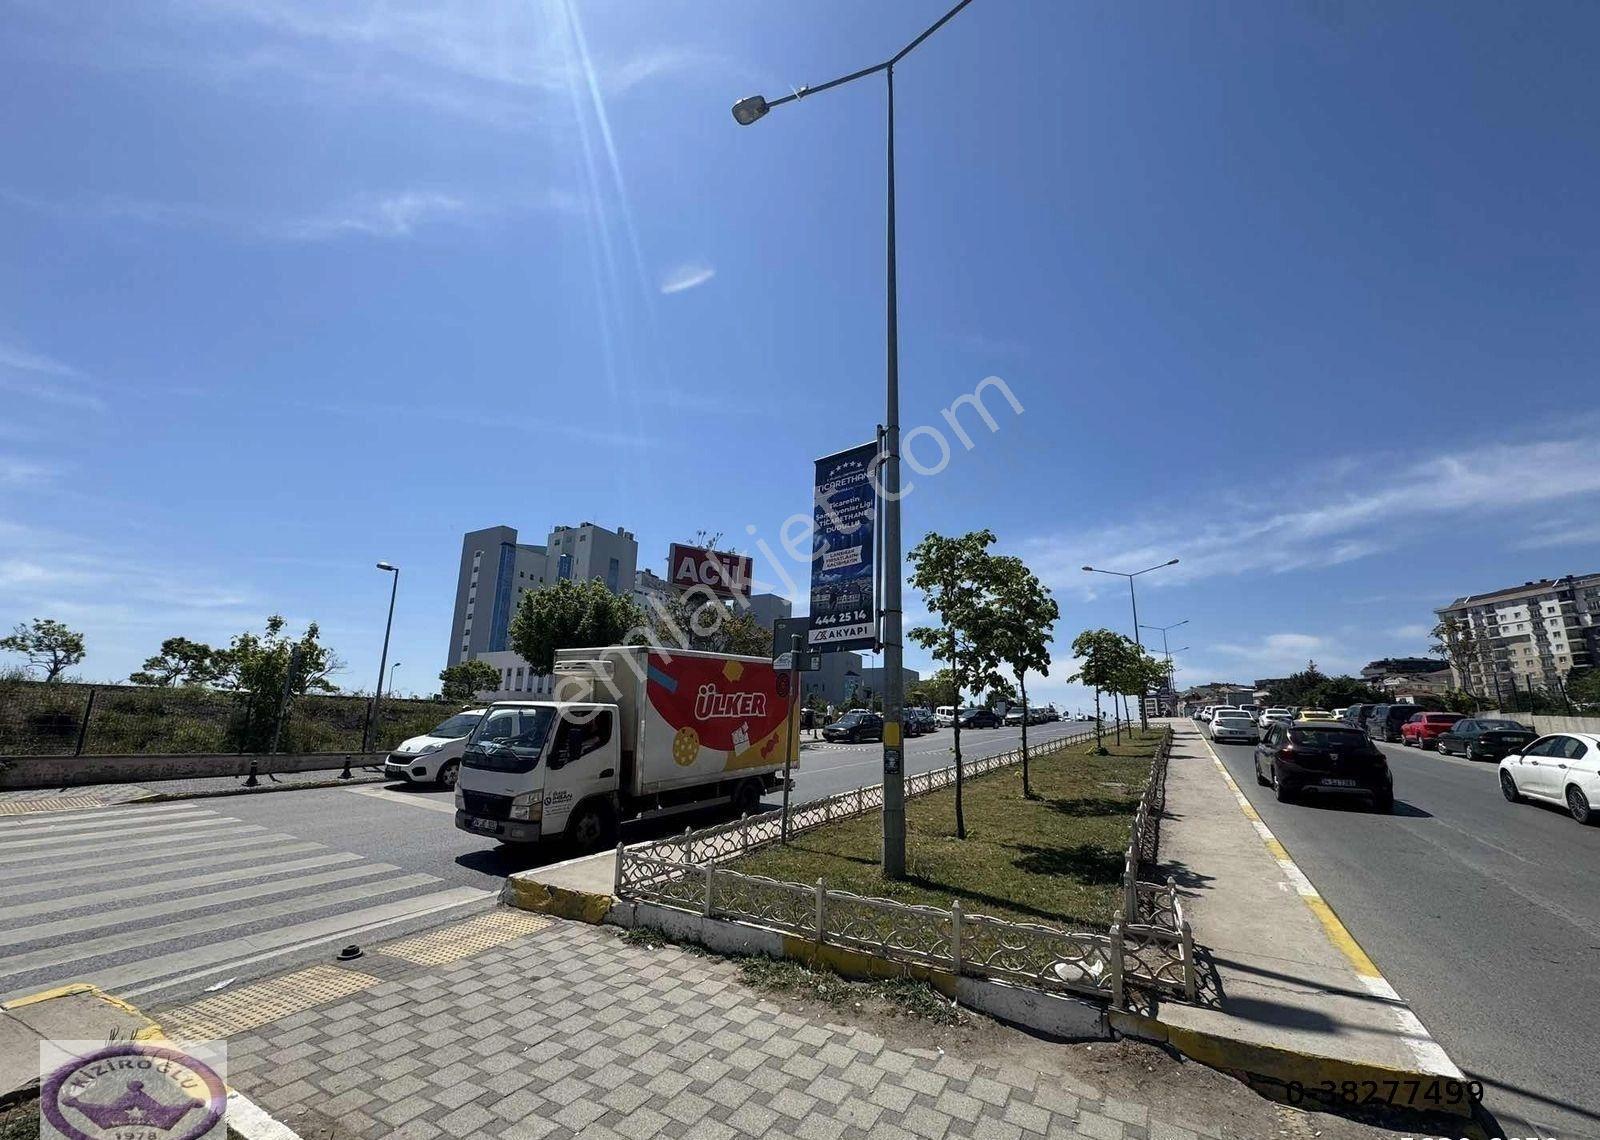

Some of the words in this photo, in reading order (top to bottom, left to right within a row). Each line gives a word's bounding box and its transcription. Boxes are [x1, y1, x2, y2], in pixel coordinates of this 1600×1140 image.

[815, 614, 837, 626] 444
[838, 612, 852, 623] 25
[853, 609, 867, 620] 14
[828, 626, 868, 639] AKYAPI
[694, 683, 767, 720] ÜLKER
